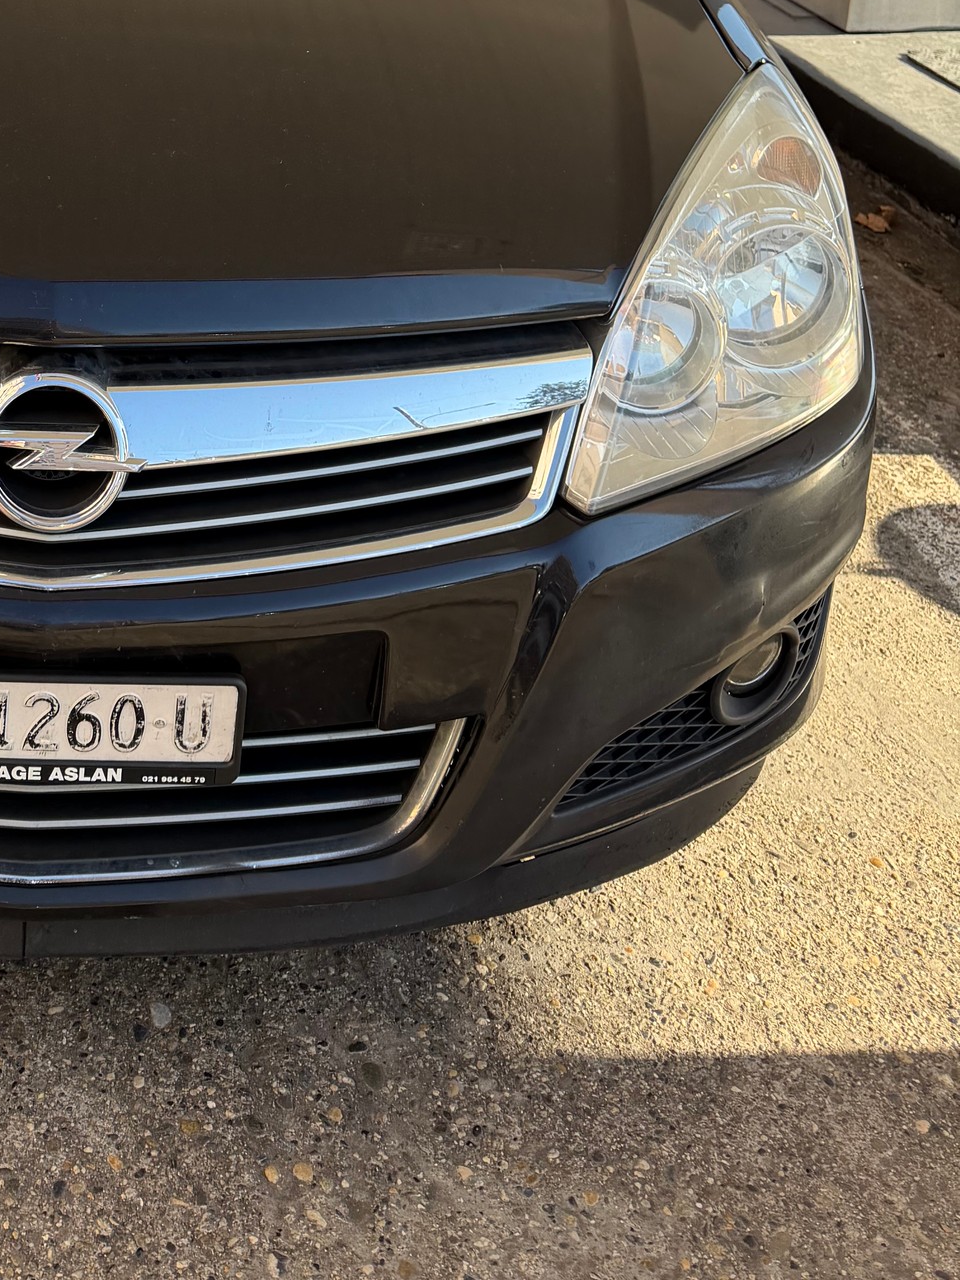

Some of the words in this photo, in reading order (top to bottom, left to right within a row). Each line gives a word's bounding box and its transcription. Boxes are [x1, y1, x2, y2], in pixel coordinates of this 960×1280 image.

[174, 692, 214, 754] U
[48, 766, 122, 782] ASLAN
[142, 775, 158, 783] 021
